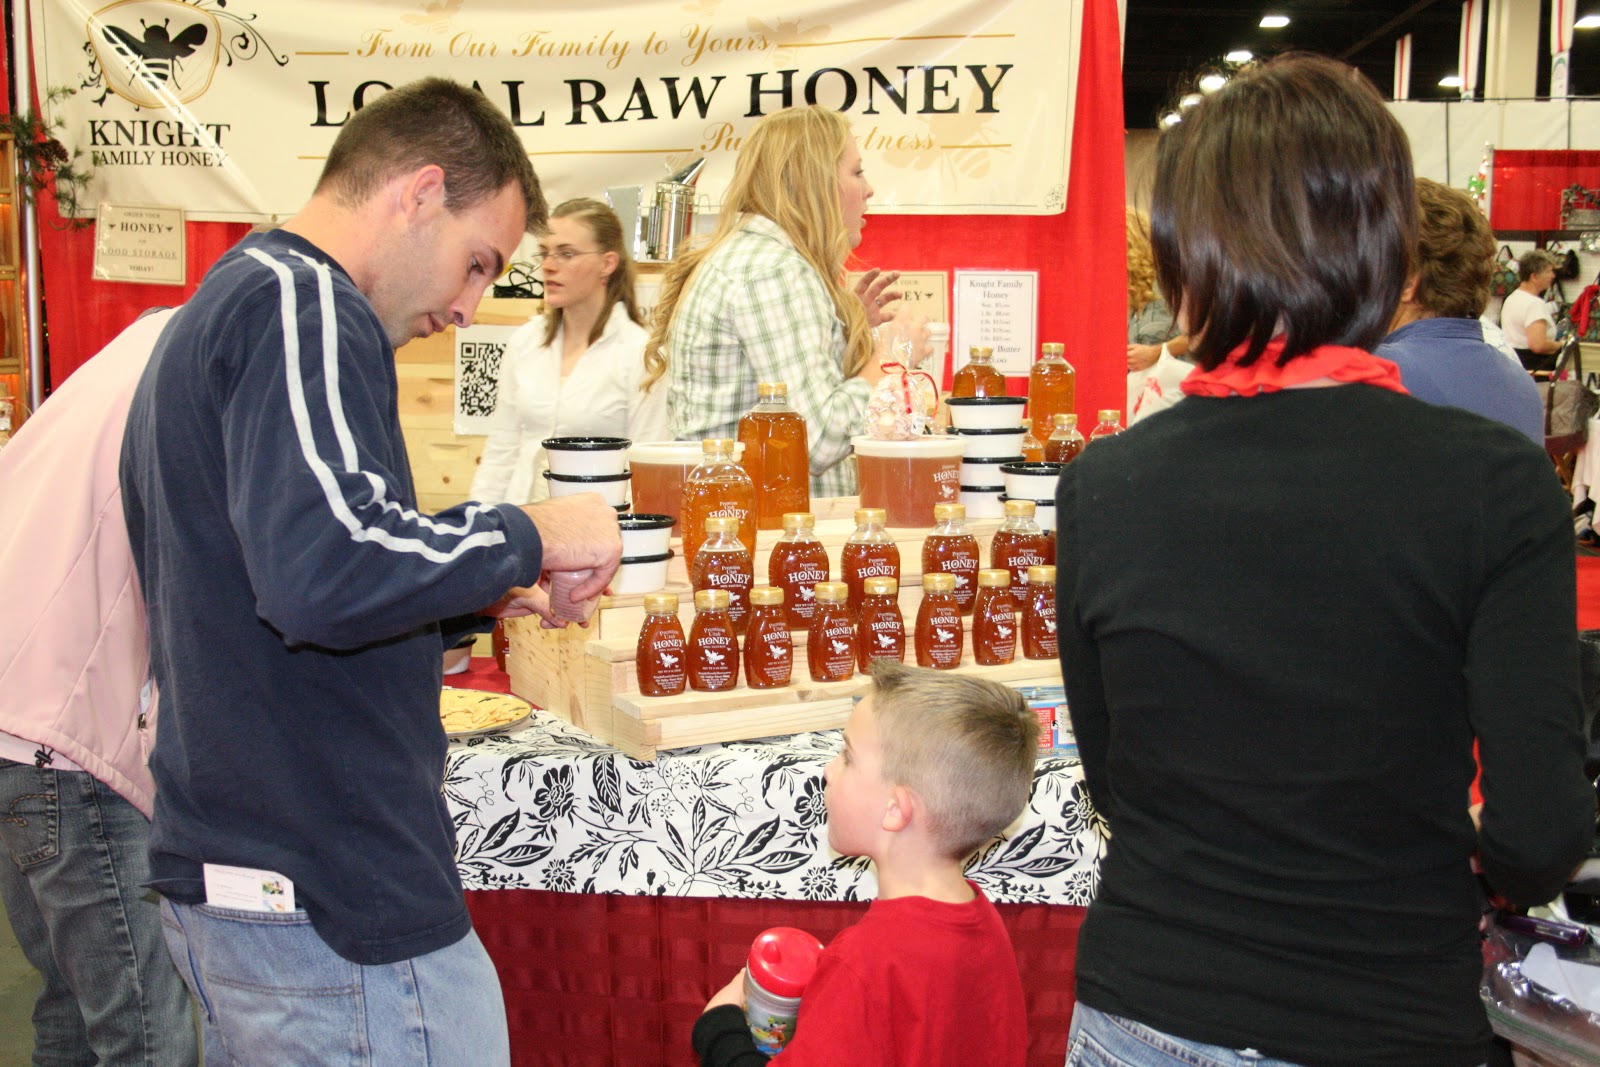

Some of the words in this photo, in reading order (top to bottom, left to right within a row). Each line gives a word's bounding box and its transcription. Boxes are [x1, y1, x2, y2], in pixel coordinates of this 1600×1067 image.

[357, 28, 435, 57] From
[449, 31, 500, 57] Our
[512, 30, 631, 70] Family
[643, 31, 670, 56] to
[680, 23, 772, 67] Yours
[307, 79, 545, 127] LOL
[563, 76, 727, 125] RAW
[743, 64, 1014, 118] HONEY
[88, 119, 230, 149] KNIGHT
[92, 150, 155, 166] FAMILY
[161, 151, 228, 167] HONEY
[120, 221, 164, 234] HONEY
[132, 249, 178, 260] STORAGE
[129, 264, 155, 273] TODAY!
[969, 279, 996, 289] Knight
[997, 280, 1024, 289] Family
[983, 290, 1009, 300] Honey
[997, 345, 1021, 353] Butter
[708, 509, 749, 519] HONEY
[941, 559, 977, 571] HONEY
[1008, 556, 1046, 567] HONEY
[788, 571, 828, 583] HONEY
[857, 566, 896, 578] HONEY
[709, 574, 750, 586] HONEY
[1039, 608, 1056, 617] HON
[871, 621, 901, 631] HONEY
[930, 616, 960, 625] HONEY
[825, 627, 854, 637] HONEY
[653, 639, 684, 650] HONEY
[698, 636, 731, 646] HONEY
